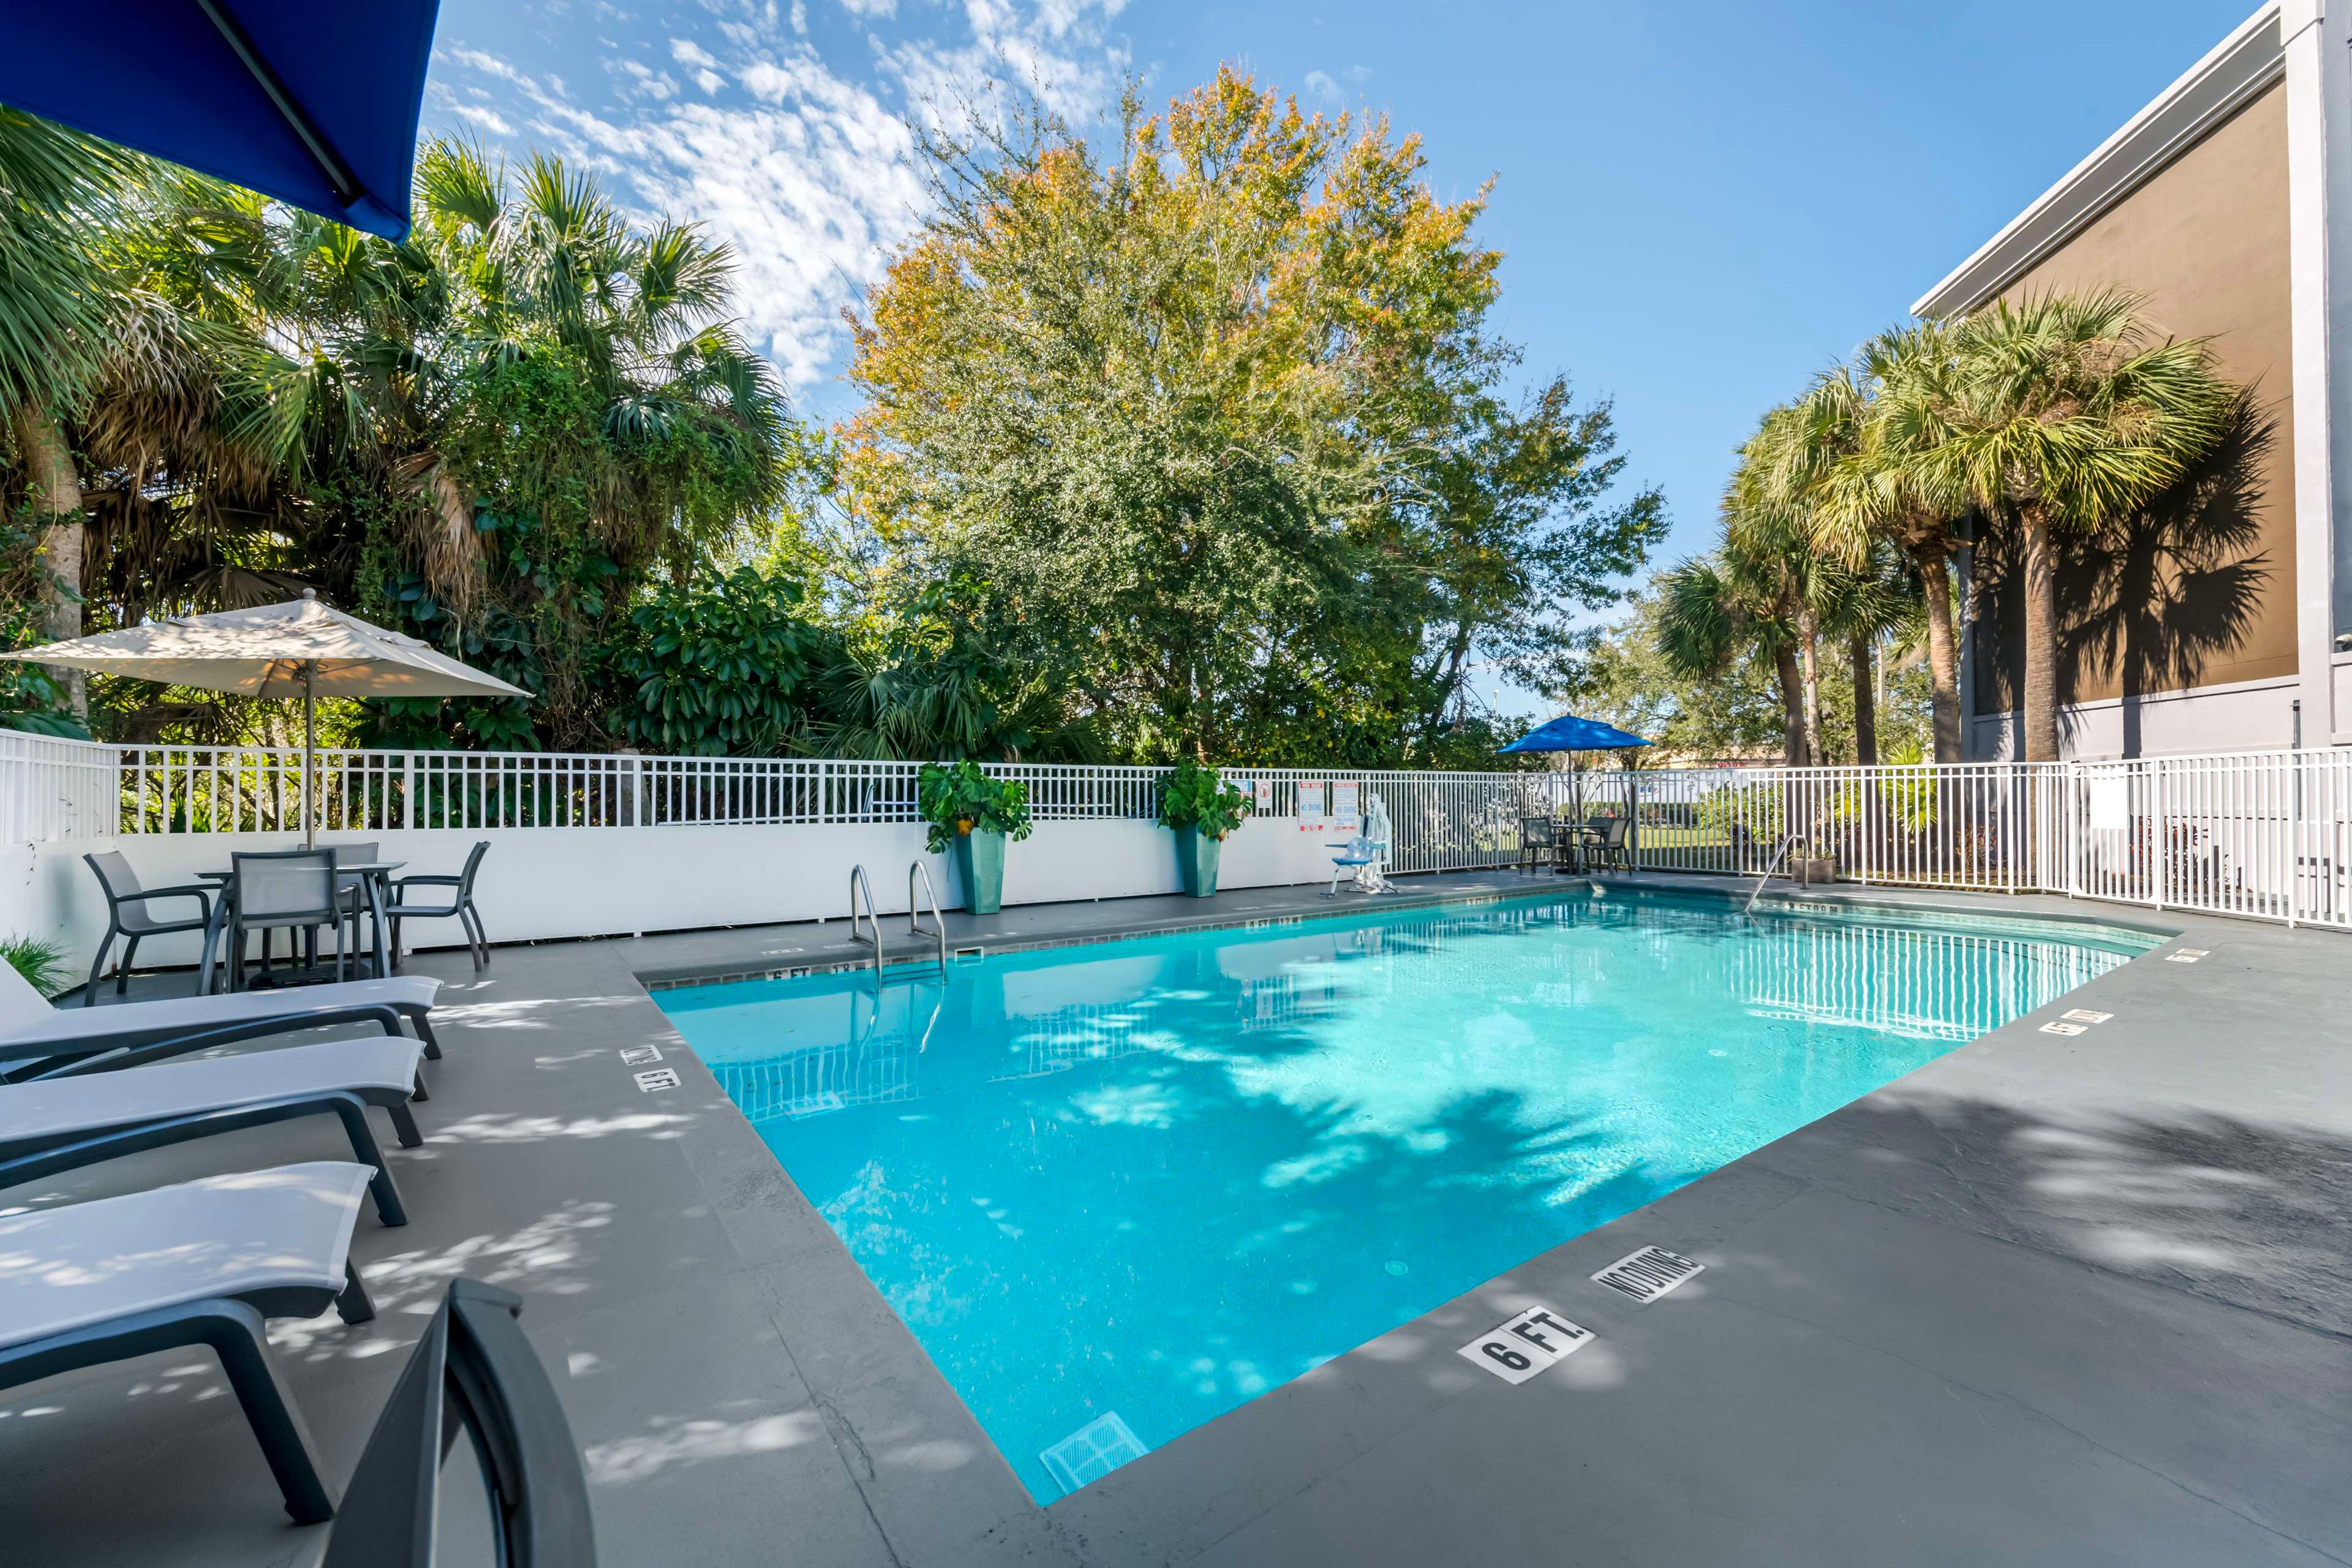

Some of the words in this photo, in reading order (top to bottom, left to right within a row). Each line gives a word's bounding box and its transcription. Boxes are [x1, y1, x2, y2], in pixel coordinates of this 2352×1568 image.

[791, 967, 809, 978] FT
[1616, 1248, 1700, 1289] DIVING
[1597, 1272, 1656, 1300] NO
[1482, 1342, 1531, 1371] 6
[1510, 1311, 1585, 1354] FT.
